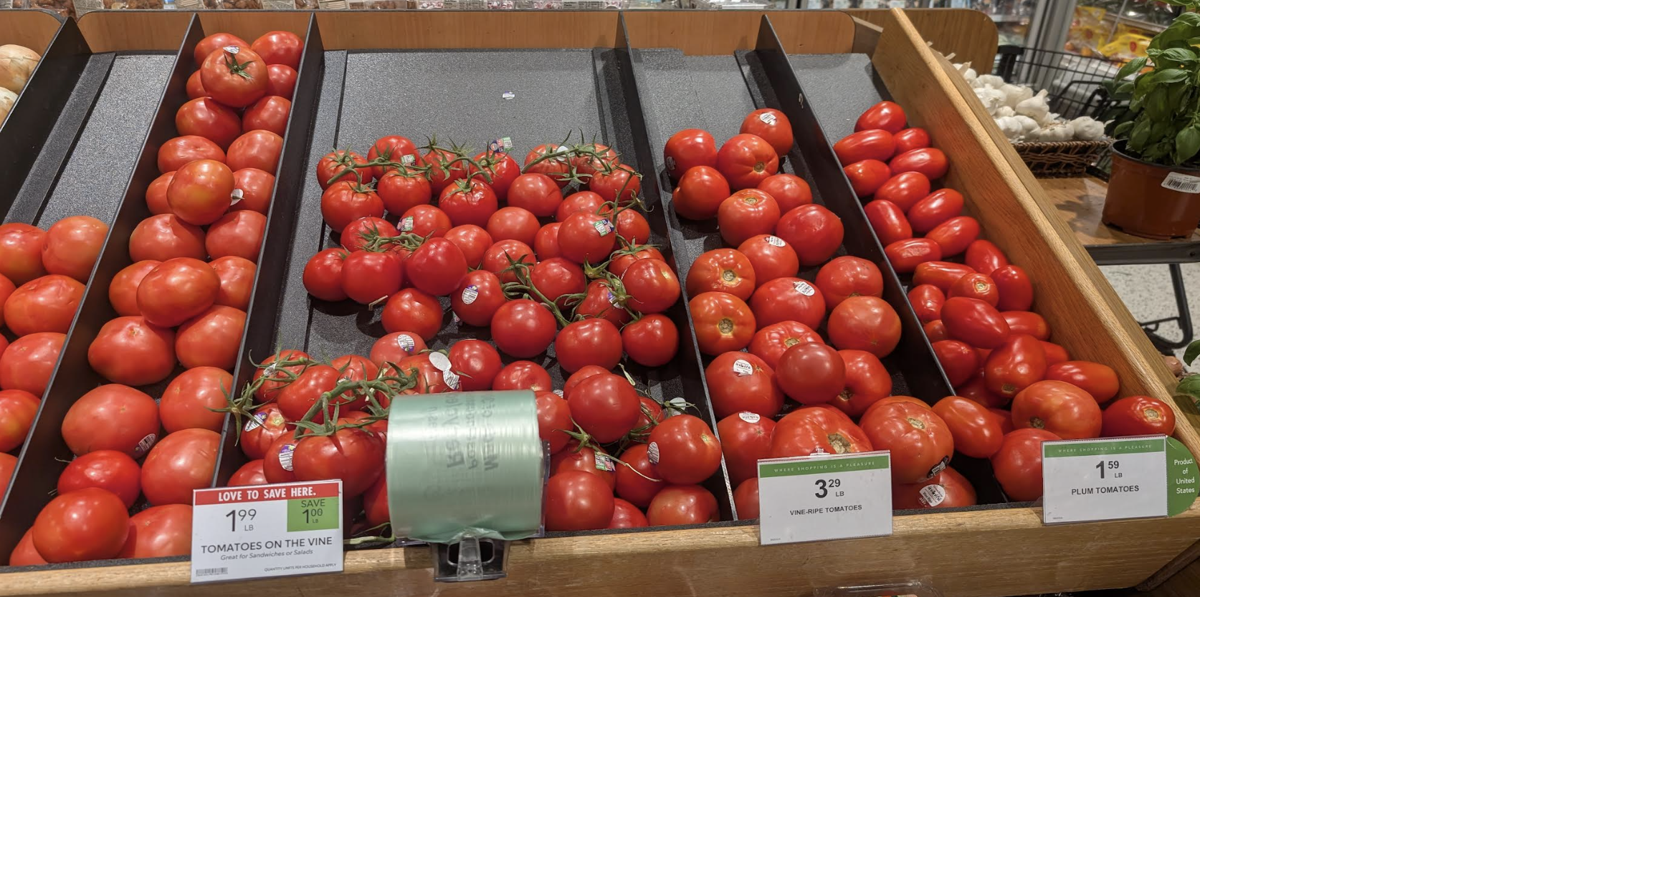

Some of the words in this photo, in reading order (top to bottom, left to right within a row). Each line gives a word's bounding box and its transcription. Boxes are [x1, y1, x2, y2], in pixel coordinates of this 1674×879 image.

[1173, 458, 1193, 466] Product
[1175, 477, 1195, 485] United
[218, 491, 243, 502] LOVE
[247, 490, 259, 500] TO
[263, 488, 287, 499] SAVE
[290, 486, 317, 497] HERE.
[1071, 487, 1094, 496] PLUM
[1095, 485, 1140, 494] TOMATOES
[301, 498, 326, 508] SAVE
[789, 507, 824, 516] VINE-RIPE
[825, 504, 863, 513] TOMATOES
[201, 541, 263, 554] TOMATOES
[264, 540, 282, 550] ON
[284, 538, 306, 548] THE
[307, 536, 333, 547] VINE
[220, 553, 239, 561] Great
[239, 552, 249, 560] for
[249, 551, 285, 559] Sandwiches
